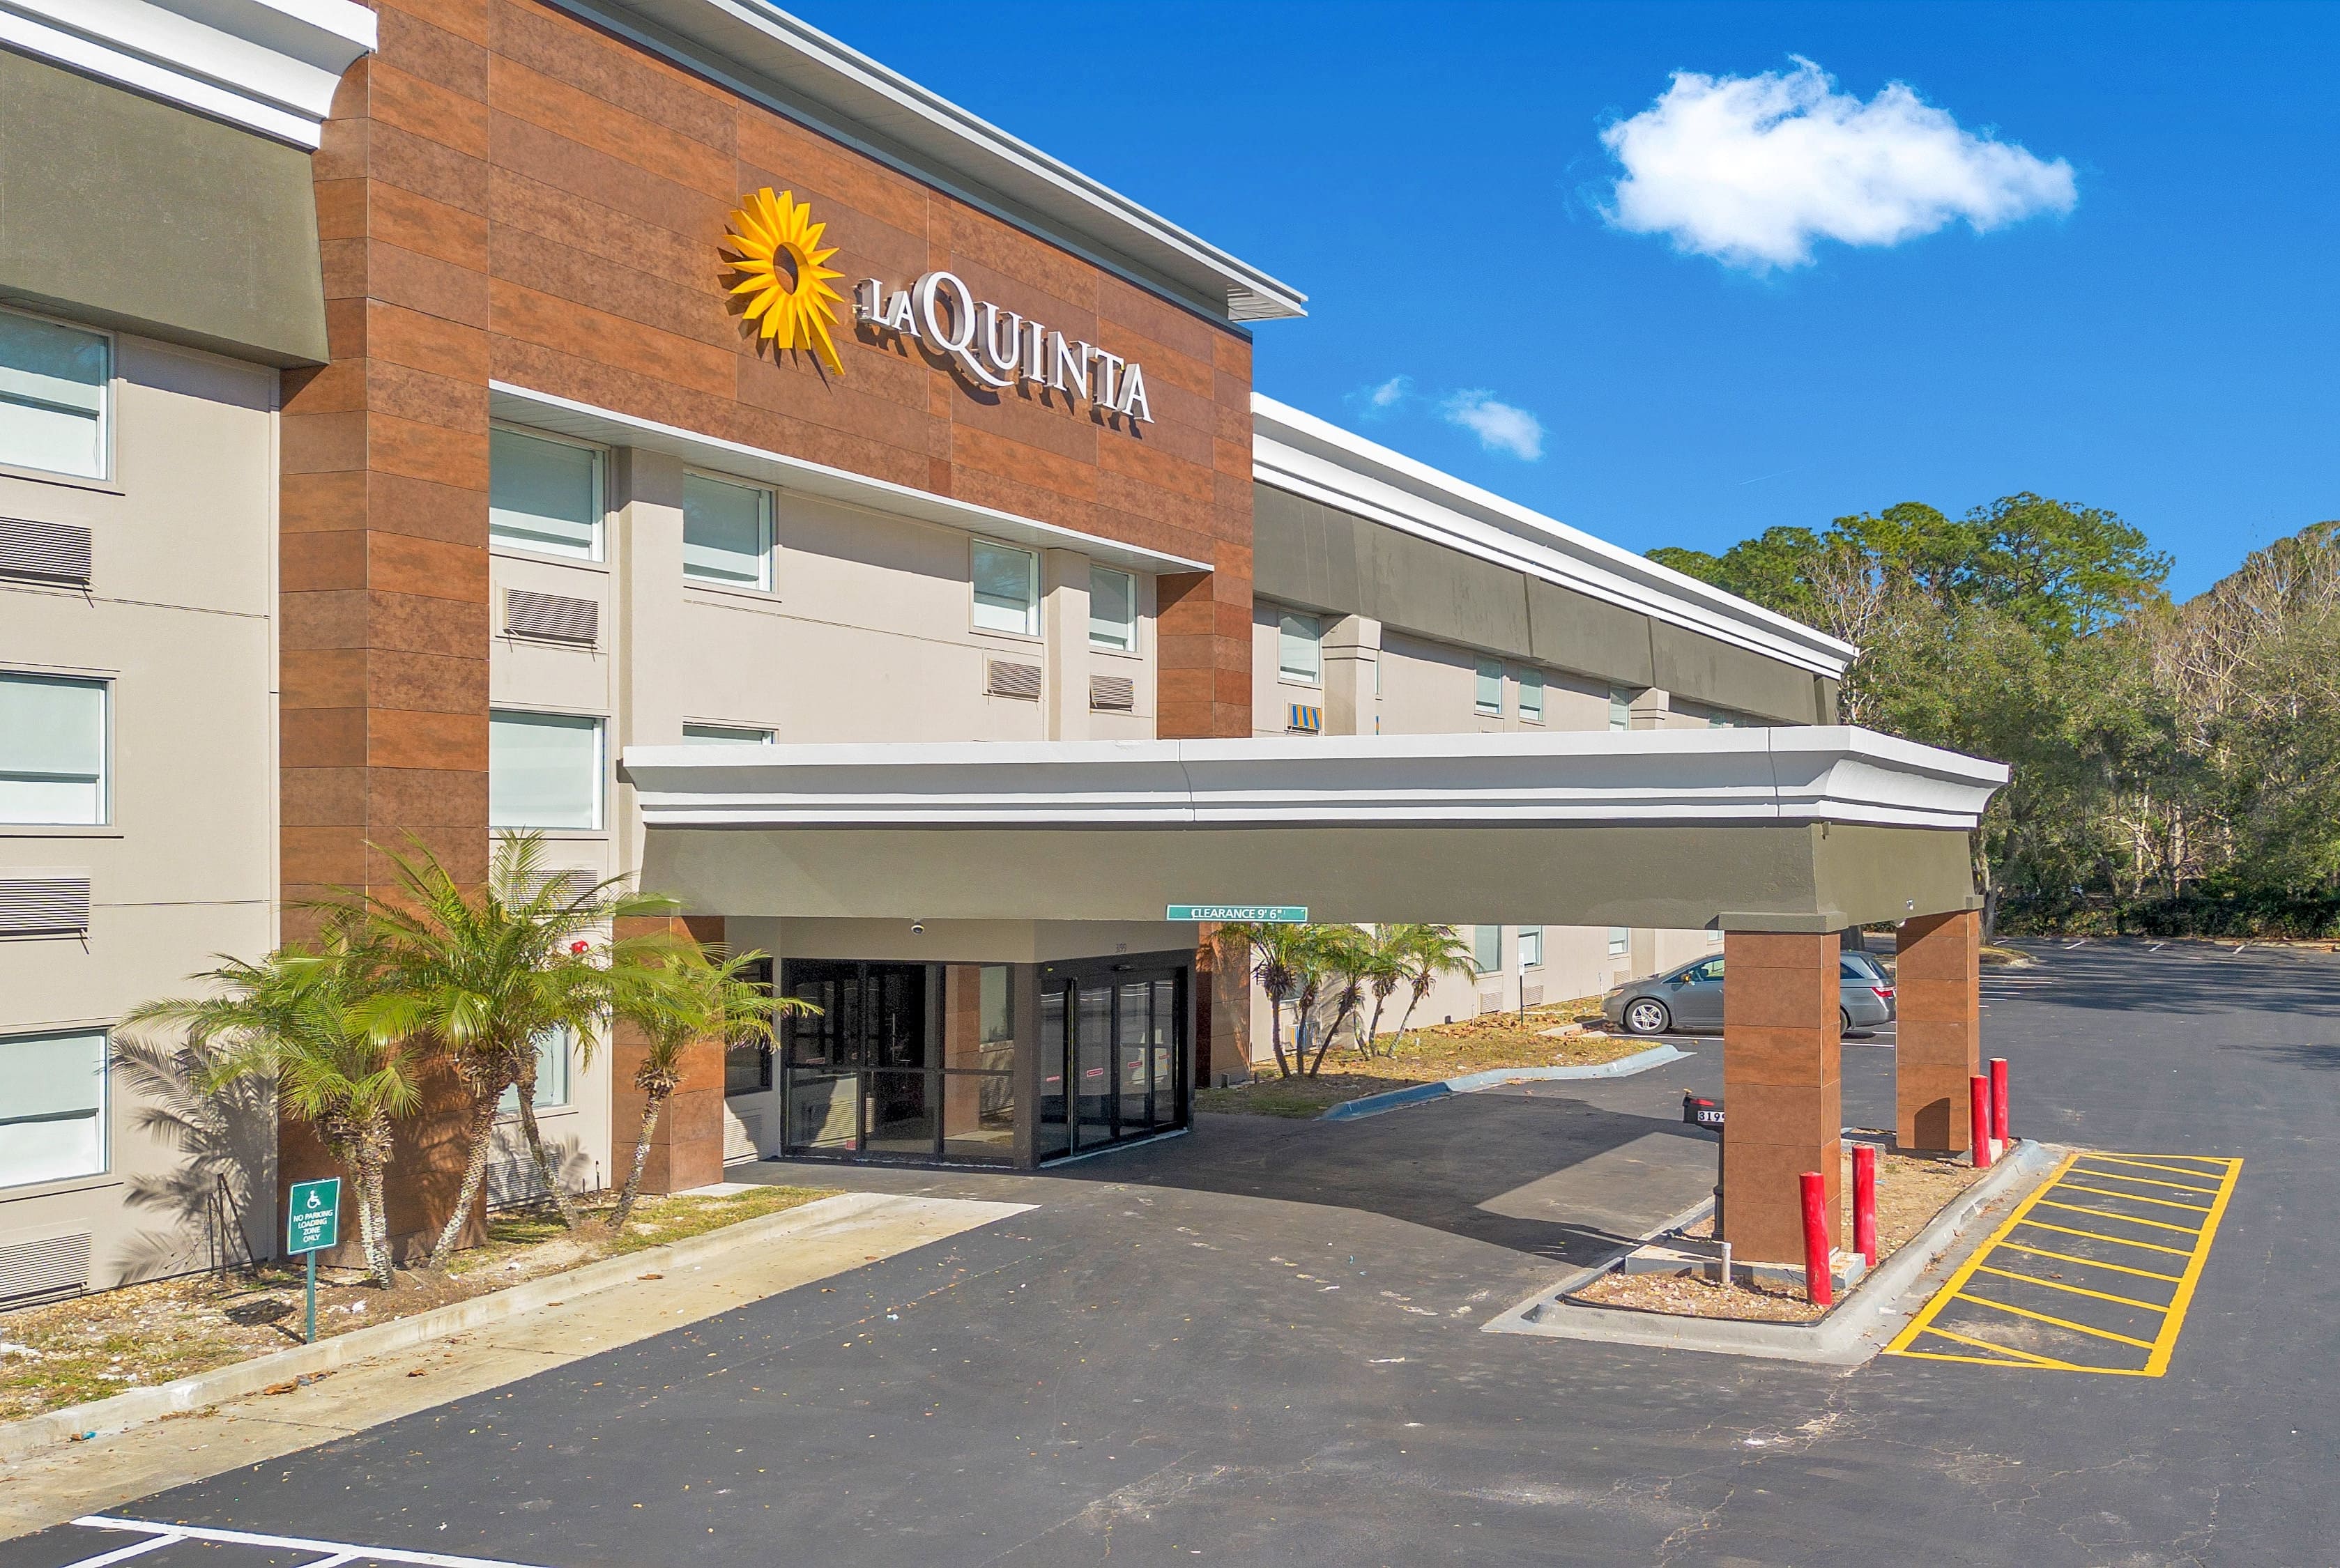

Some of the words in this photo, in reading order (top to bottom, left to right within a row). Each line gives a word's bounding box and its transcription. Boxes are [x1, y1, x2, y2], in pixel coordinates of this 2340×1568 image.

[858, 277, 921, 337] LA
[913, 270, 1154, 423] QUINTA
[1191, 908, 1255, 919] CLEARANCE
[1257, 909, 1267, 919] 9'
[305, 1209, 333, 1220] PARKING
[298, 1217, 328, 1229] LOADING
[303, 1227, 321, 1236] ZONE
[303, 1233, 321, 1243] ONLY
